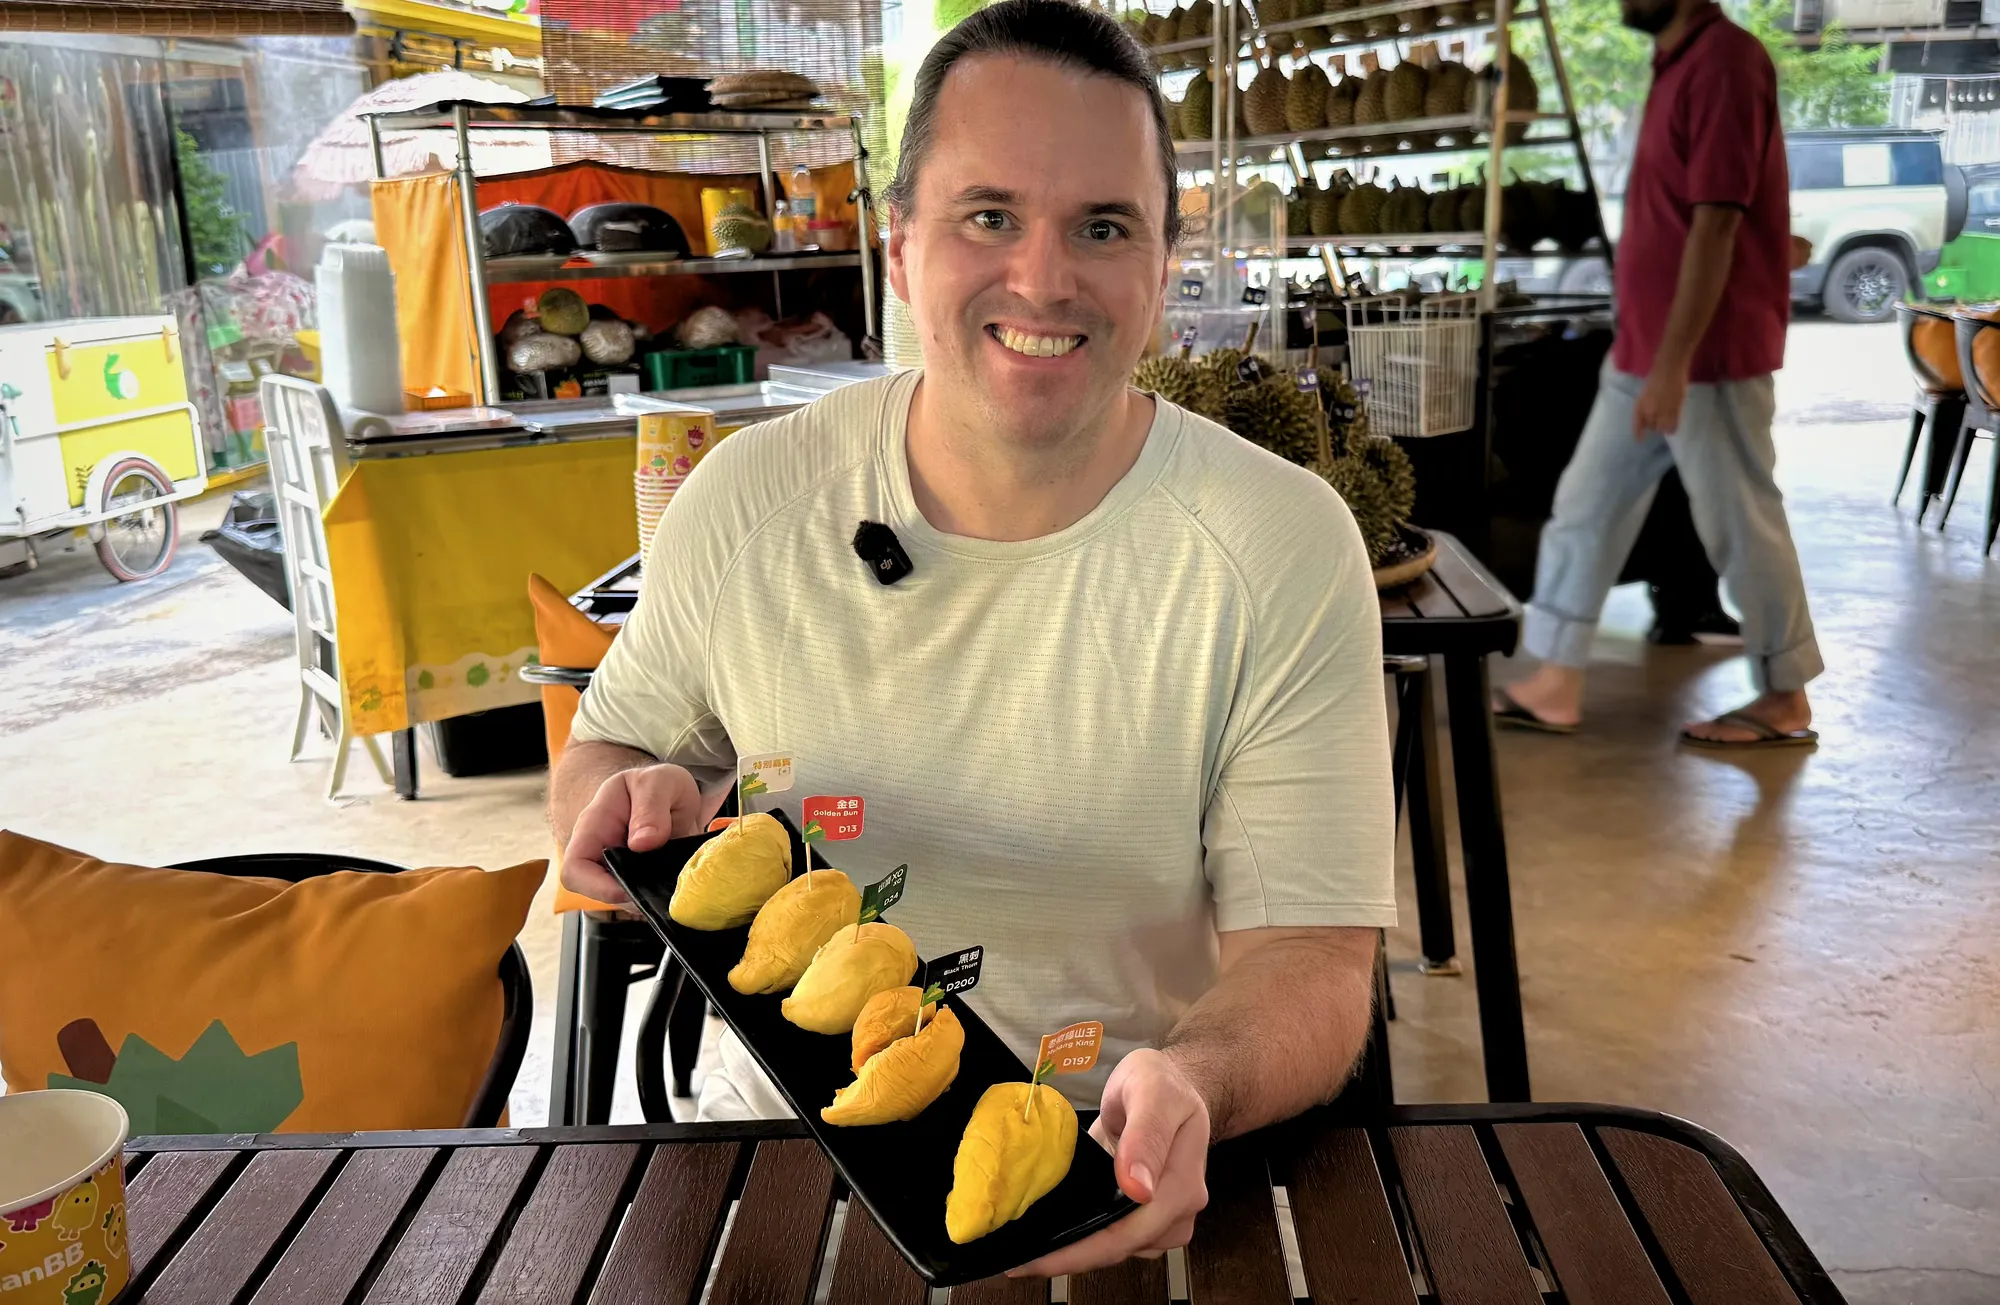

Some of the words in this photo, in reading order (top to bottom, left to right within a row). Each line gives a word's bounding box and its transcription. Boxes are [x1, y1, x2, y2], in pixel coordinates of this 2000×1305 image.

[837, 799, 859, 810] 金包
[813, 809, 842, 817] Golden
[843, 809, 859, 817] Bun
[838, 824, 857, 834] D13
[883, 891, 899, 907] D24
[957, 949, 980, 966] 黑刺
[946, 976, 975, 993] D200
[1063, 1055, 1091, 1067] D197
[0, 1241, 85, 1293] anBB
